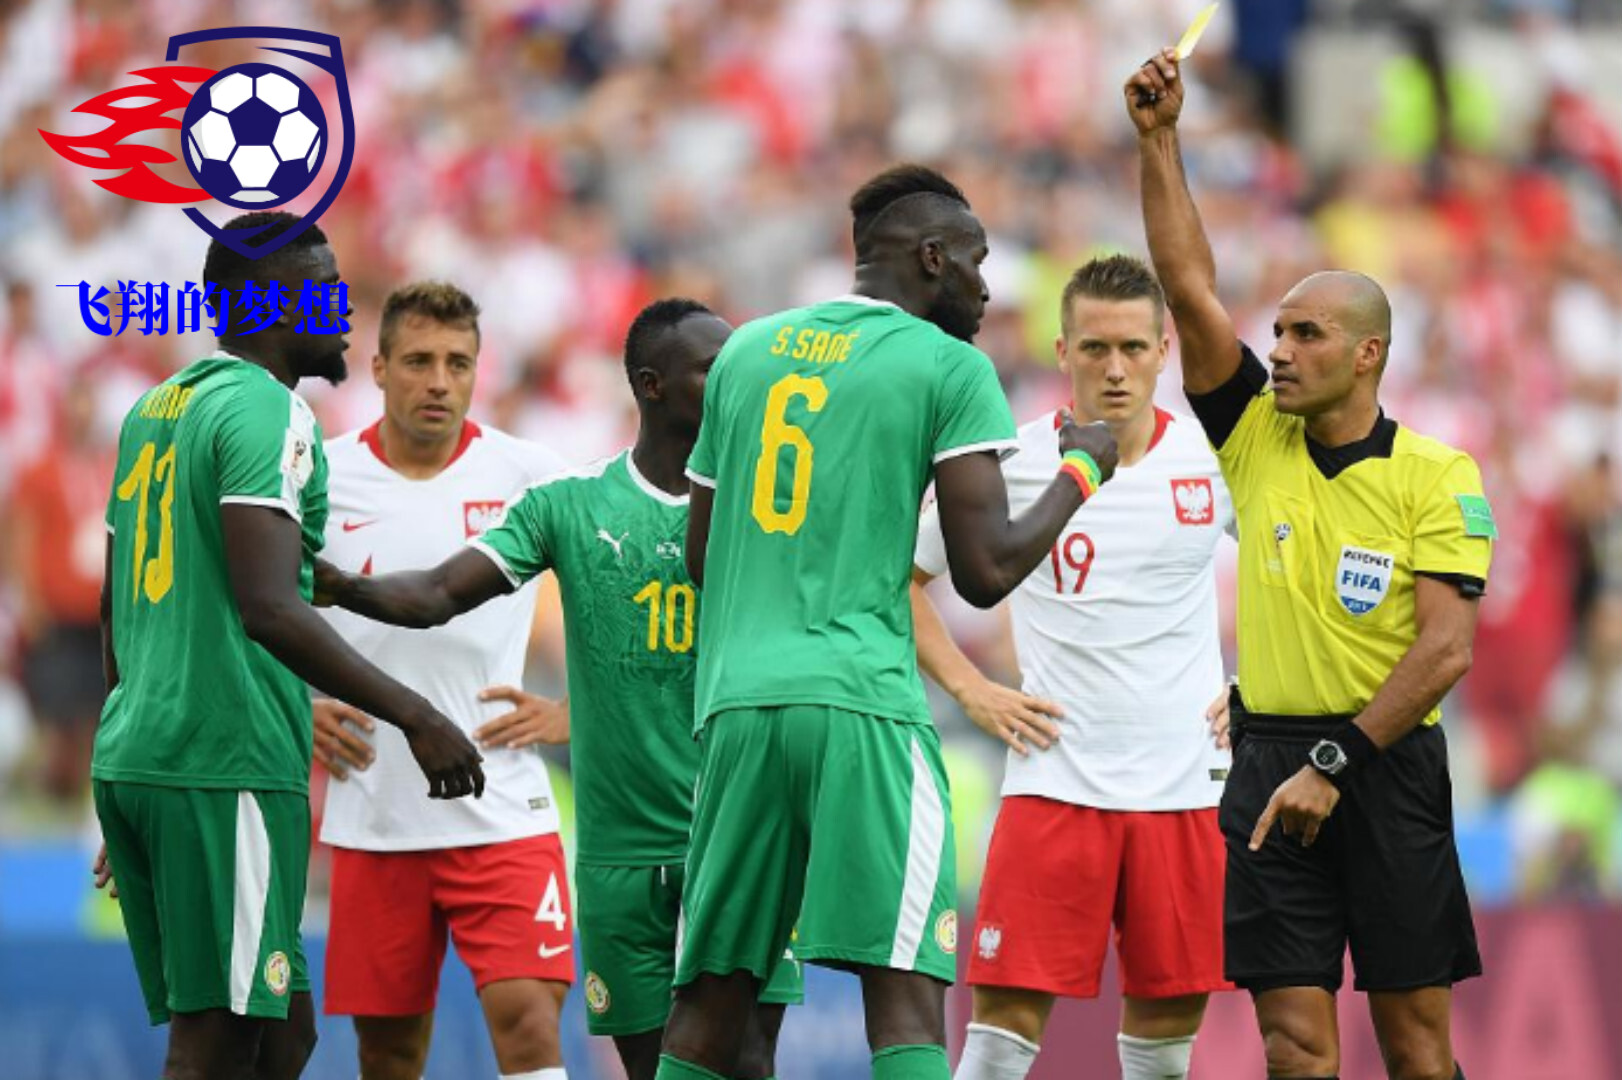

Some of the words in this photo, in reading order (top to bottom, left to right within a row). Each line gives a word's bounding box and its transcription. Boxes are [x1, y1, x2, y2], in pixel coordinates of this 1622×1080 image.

[752, 373, 828, 536] 6
[117, 442, 176, 604] 13
[1051, 532, 1095, 594] 19
[1341, 569, 1382, 592] FIFA
[633, 580, 696, 653] 10
[533, 870, 567, 932] 4
